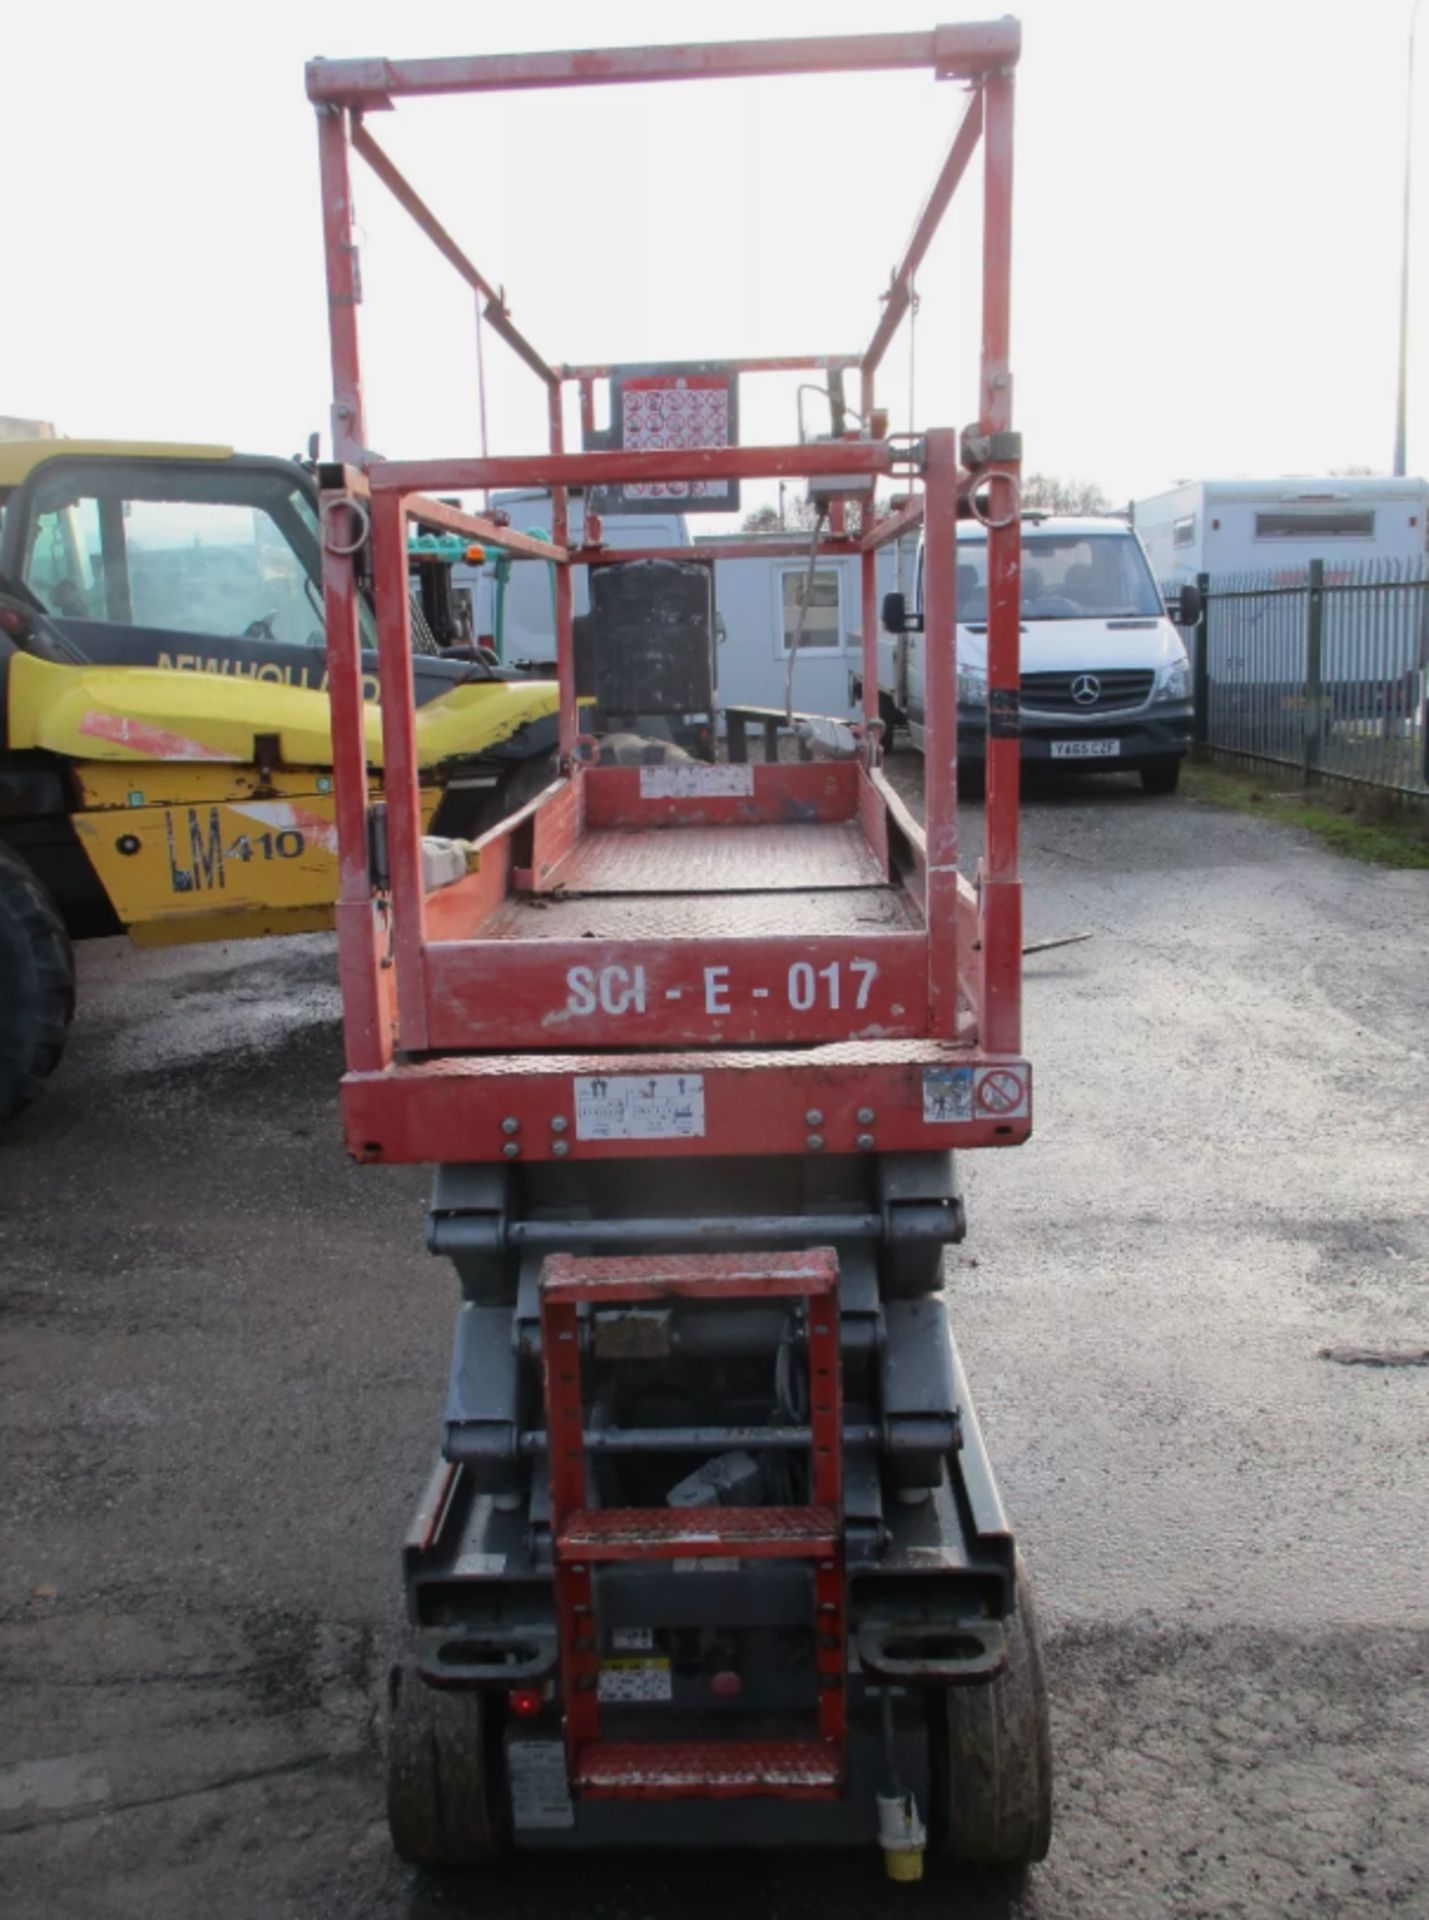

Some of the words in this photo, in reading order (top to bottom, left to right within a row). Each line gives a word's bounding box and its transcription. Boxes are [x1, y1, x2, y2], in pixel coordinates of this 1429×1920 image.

[566, 965, 646, 1015] SCI
[704, 966, 731, 1014] E
[788, 960, 877, 1010] 017
